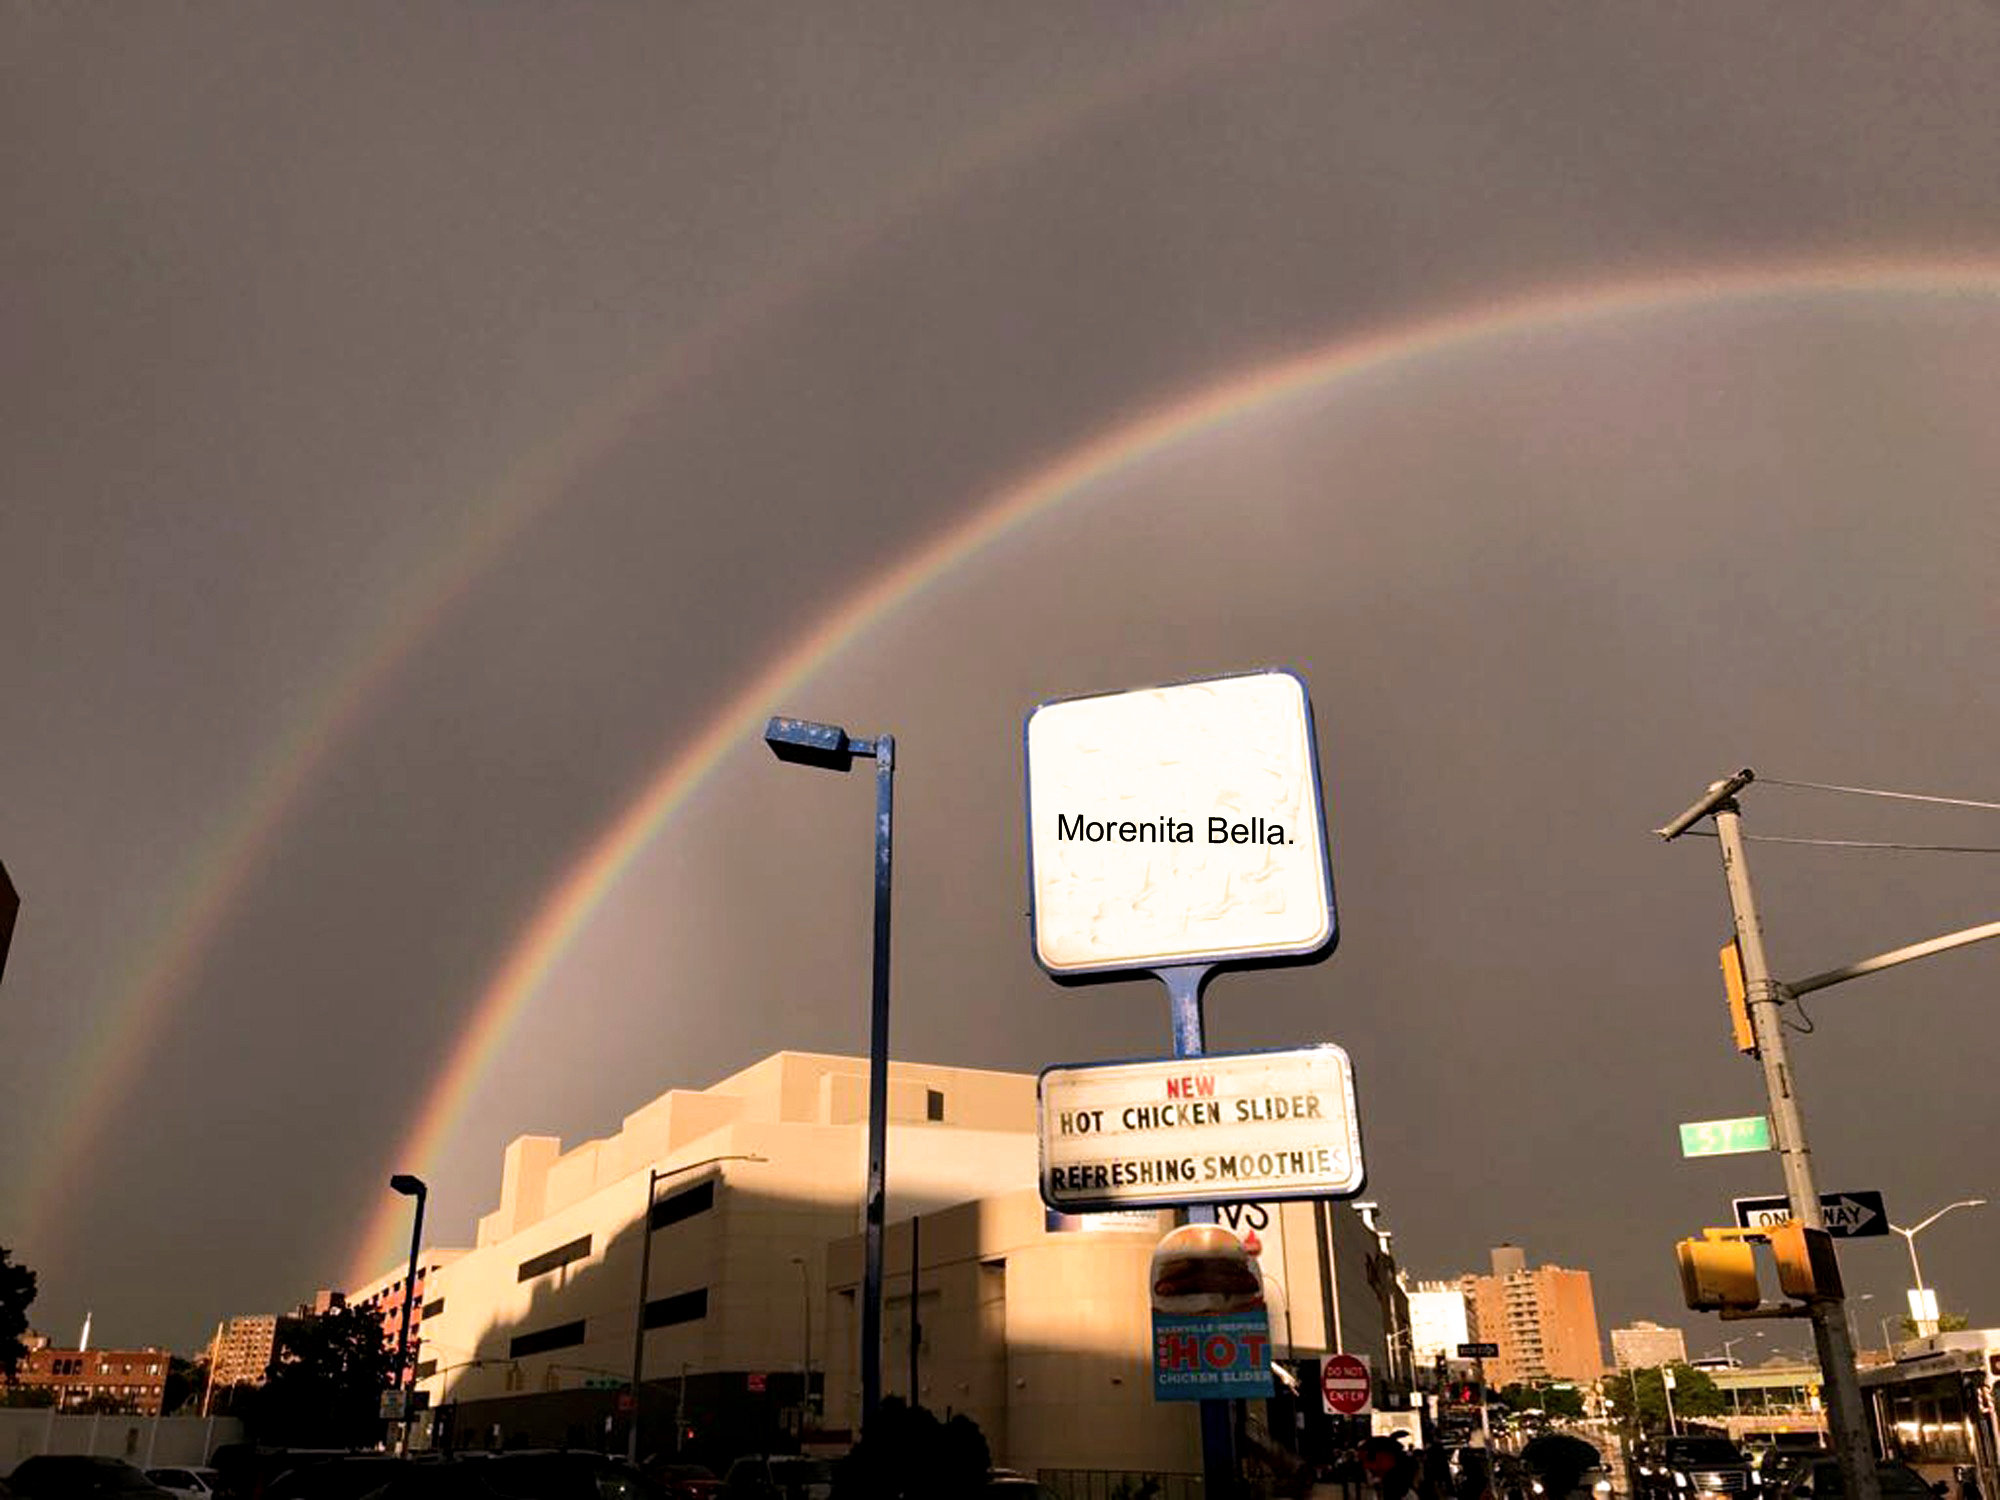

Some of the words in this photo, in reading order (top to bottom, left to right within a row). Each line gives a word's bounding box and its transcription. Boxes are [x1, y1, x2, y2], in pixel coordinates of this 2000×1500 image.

[1167, 1076, 1216, 1099] NEW
[1060, 1111, 1104, 1136] HOT
[1122, 1101, 1221, 1131] CHICKEN
[1236, 1096, 1321, 1120] SLIDER
[1051, 1157, 1196, 1190] REFRESHING
[1759, 1210, 1793, 1228] ON
[1167, 1334, 1267, 1370] HOT
[1159, 1371, 1218, 1384] CHICKEN
[1222, 1370, 1272, 1382] SLIDER
[1327, 1366, 1342, 1377] DO
[1344, 1366, 1363, 1377] NOT
[1330, 1390, 1365, 1402] ENTER
